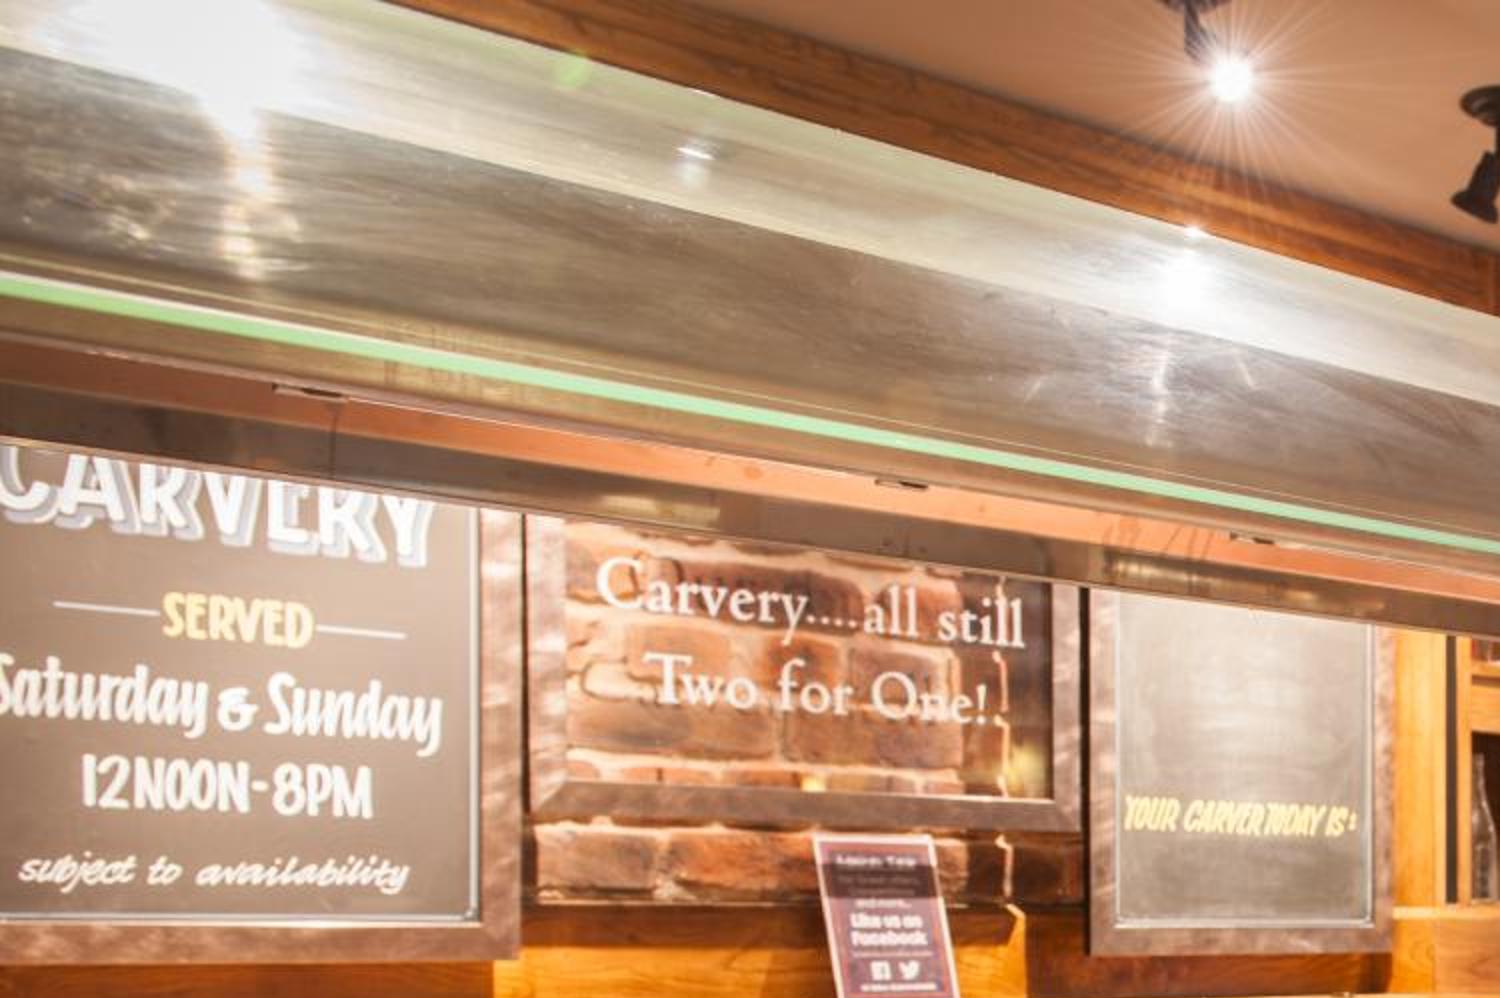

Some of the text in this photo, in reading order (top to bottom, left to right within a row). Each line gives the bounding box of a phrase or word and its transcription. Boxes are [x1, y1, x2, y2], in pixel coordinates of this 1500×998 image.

[162, 591, 315, 648] SERVED
[938, 597, 1025, 649] still
[217, 687, 258, 732] &
[265, 672, 443, 757] Sunday
[642, 651, 987, 725] Two for One!
[1124, 795, 1180, 832] YOUR
[18, 851, 411, 895] subject to availability
